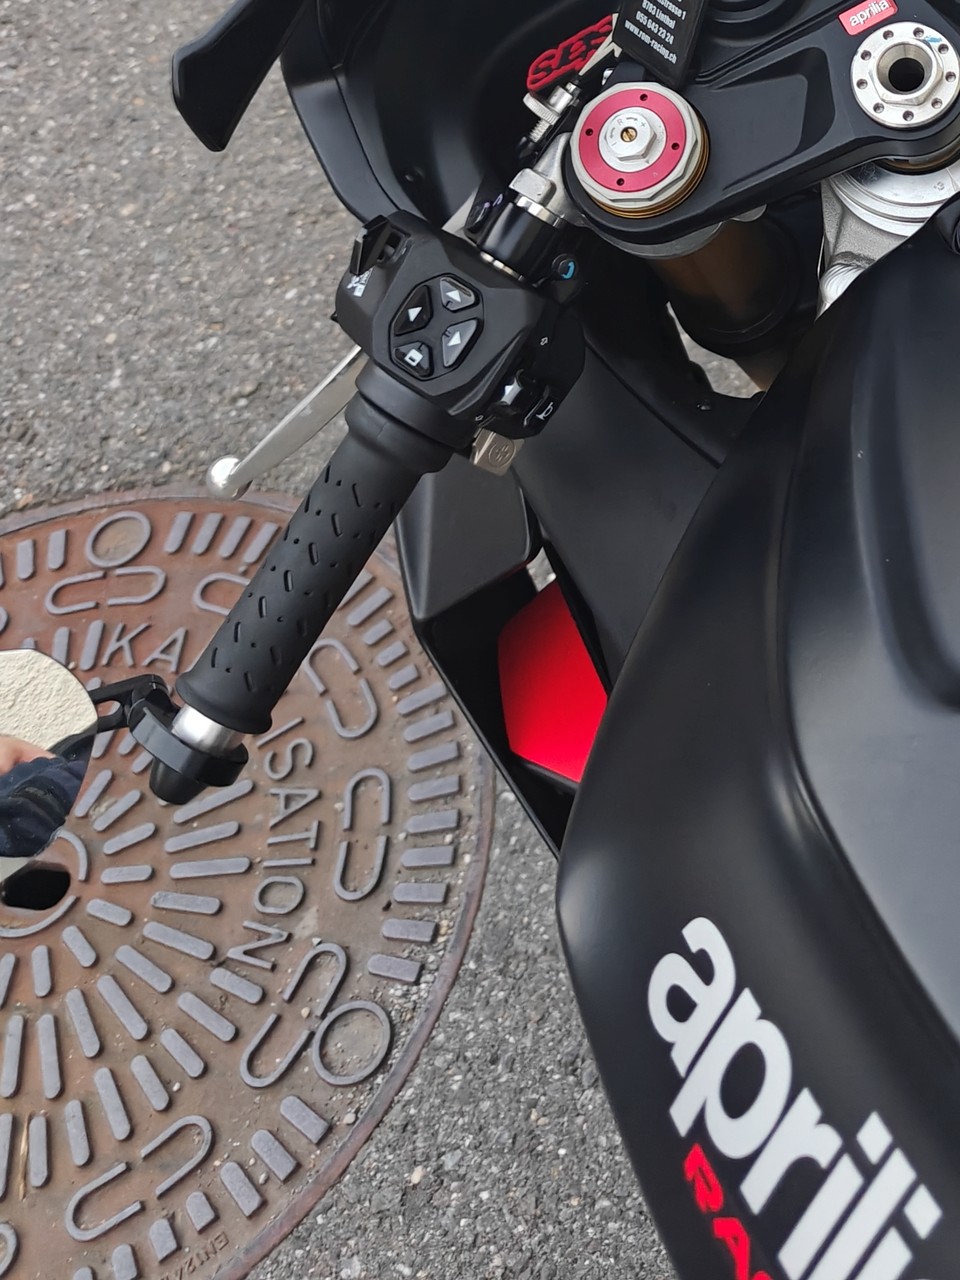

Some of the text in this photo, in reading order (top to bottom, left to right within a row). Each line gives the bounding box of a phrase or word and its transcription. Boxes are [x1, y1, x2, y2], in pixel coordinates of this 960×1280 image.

[636, 11, 674, 45] 055 643 23 24
[656, 8, 676, 29] Linthal
[682, 11, 687, 20] 1
[849, 0, 890, 26] aprilia
[625, 20, 677, 64] www.rom-racing.ch
[648, 917, 943, 1280] aprili
